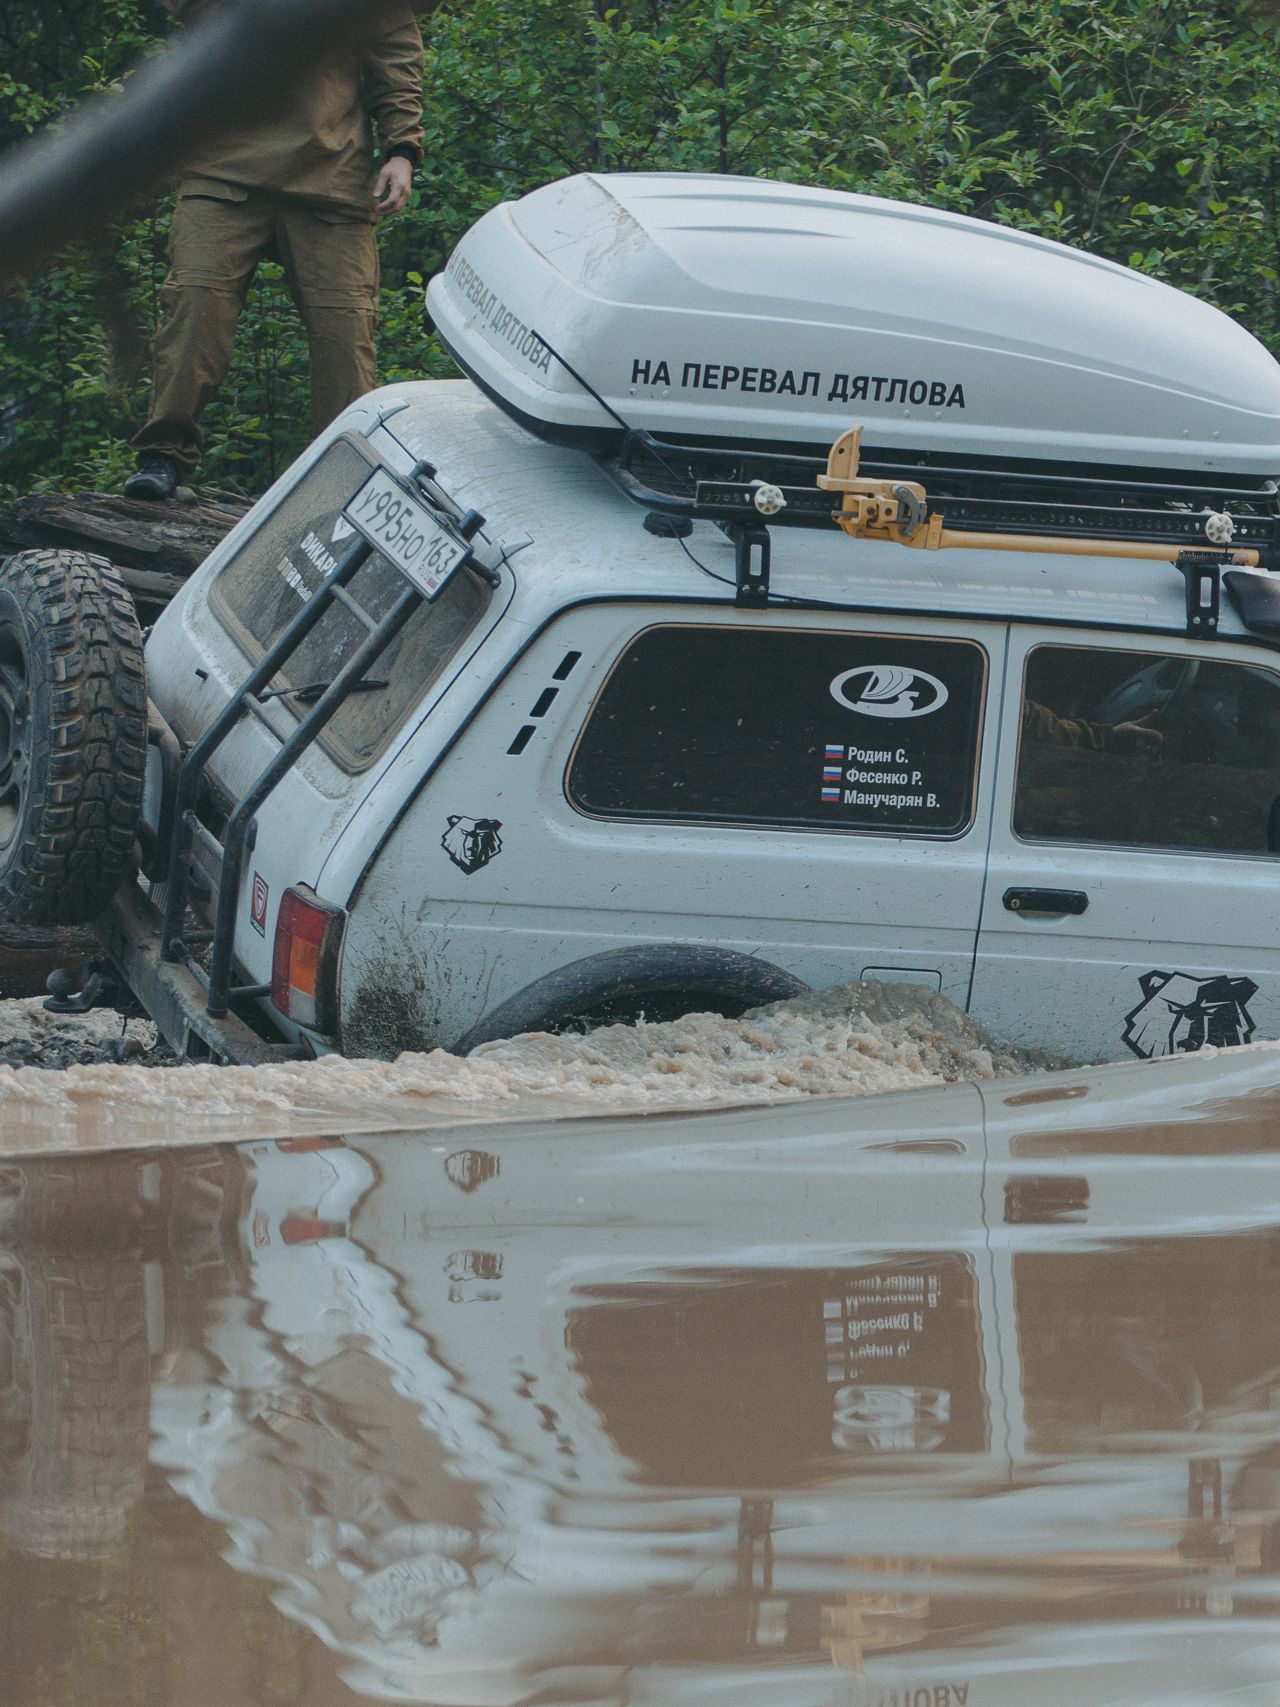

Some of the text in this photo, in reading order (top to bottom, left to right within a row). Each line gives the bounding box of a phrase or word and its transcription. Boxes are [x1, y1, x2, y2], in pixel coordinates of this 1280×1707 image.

[452, 258, 497, 319] ПЕРЕВАЛ
[490, 304, 553, 374] ДЯТЛОВА
[632, 359, 966, 408] НА ПЕРЕВАЛ ДЯТЛОВА
[423, 537, 458, 574] 163
[848, 747, 909, 763] Родин С.
[846, 768, 923, 785] Фесенко Р.
[844, 790, 941, 808] Манучарян В.
